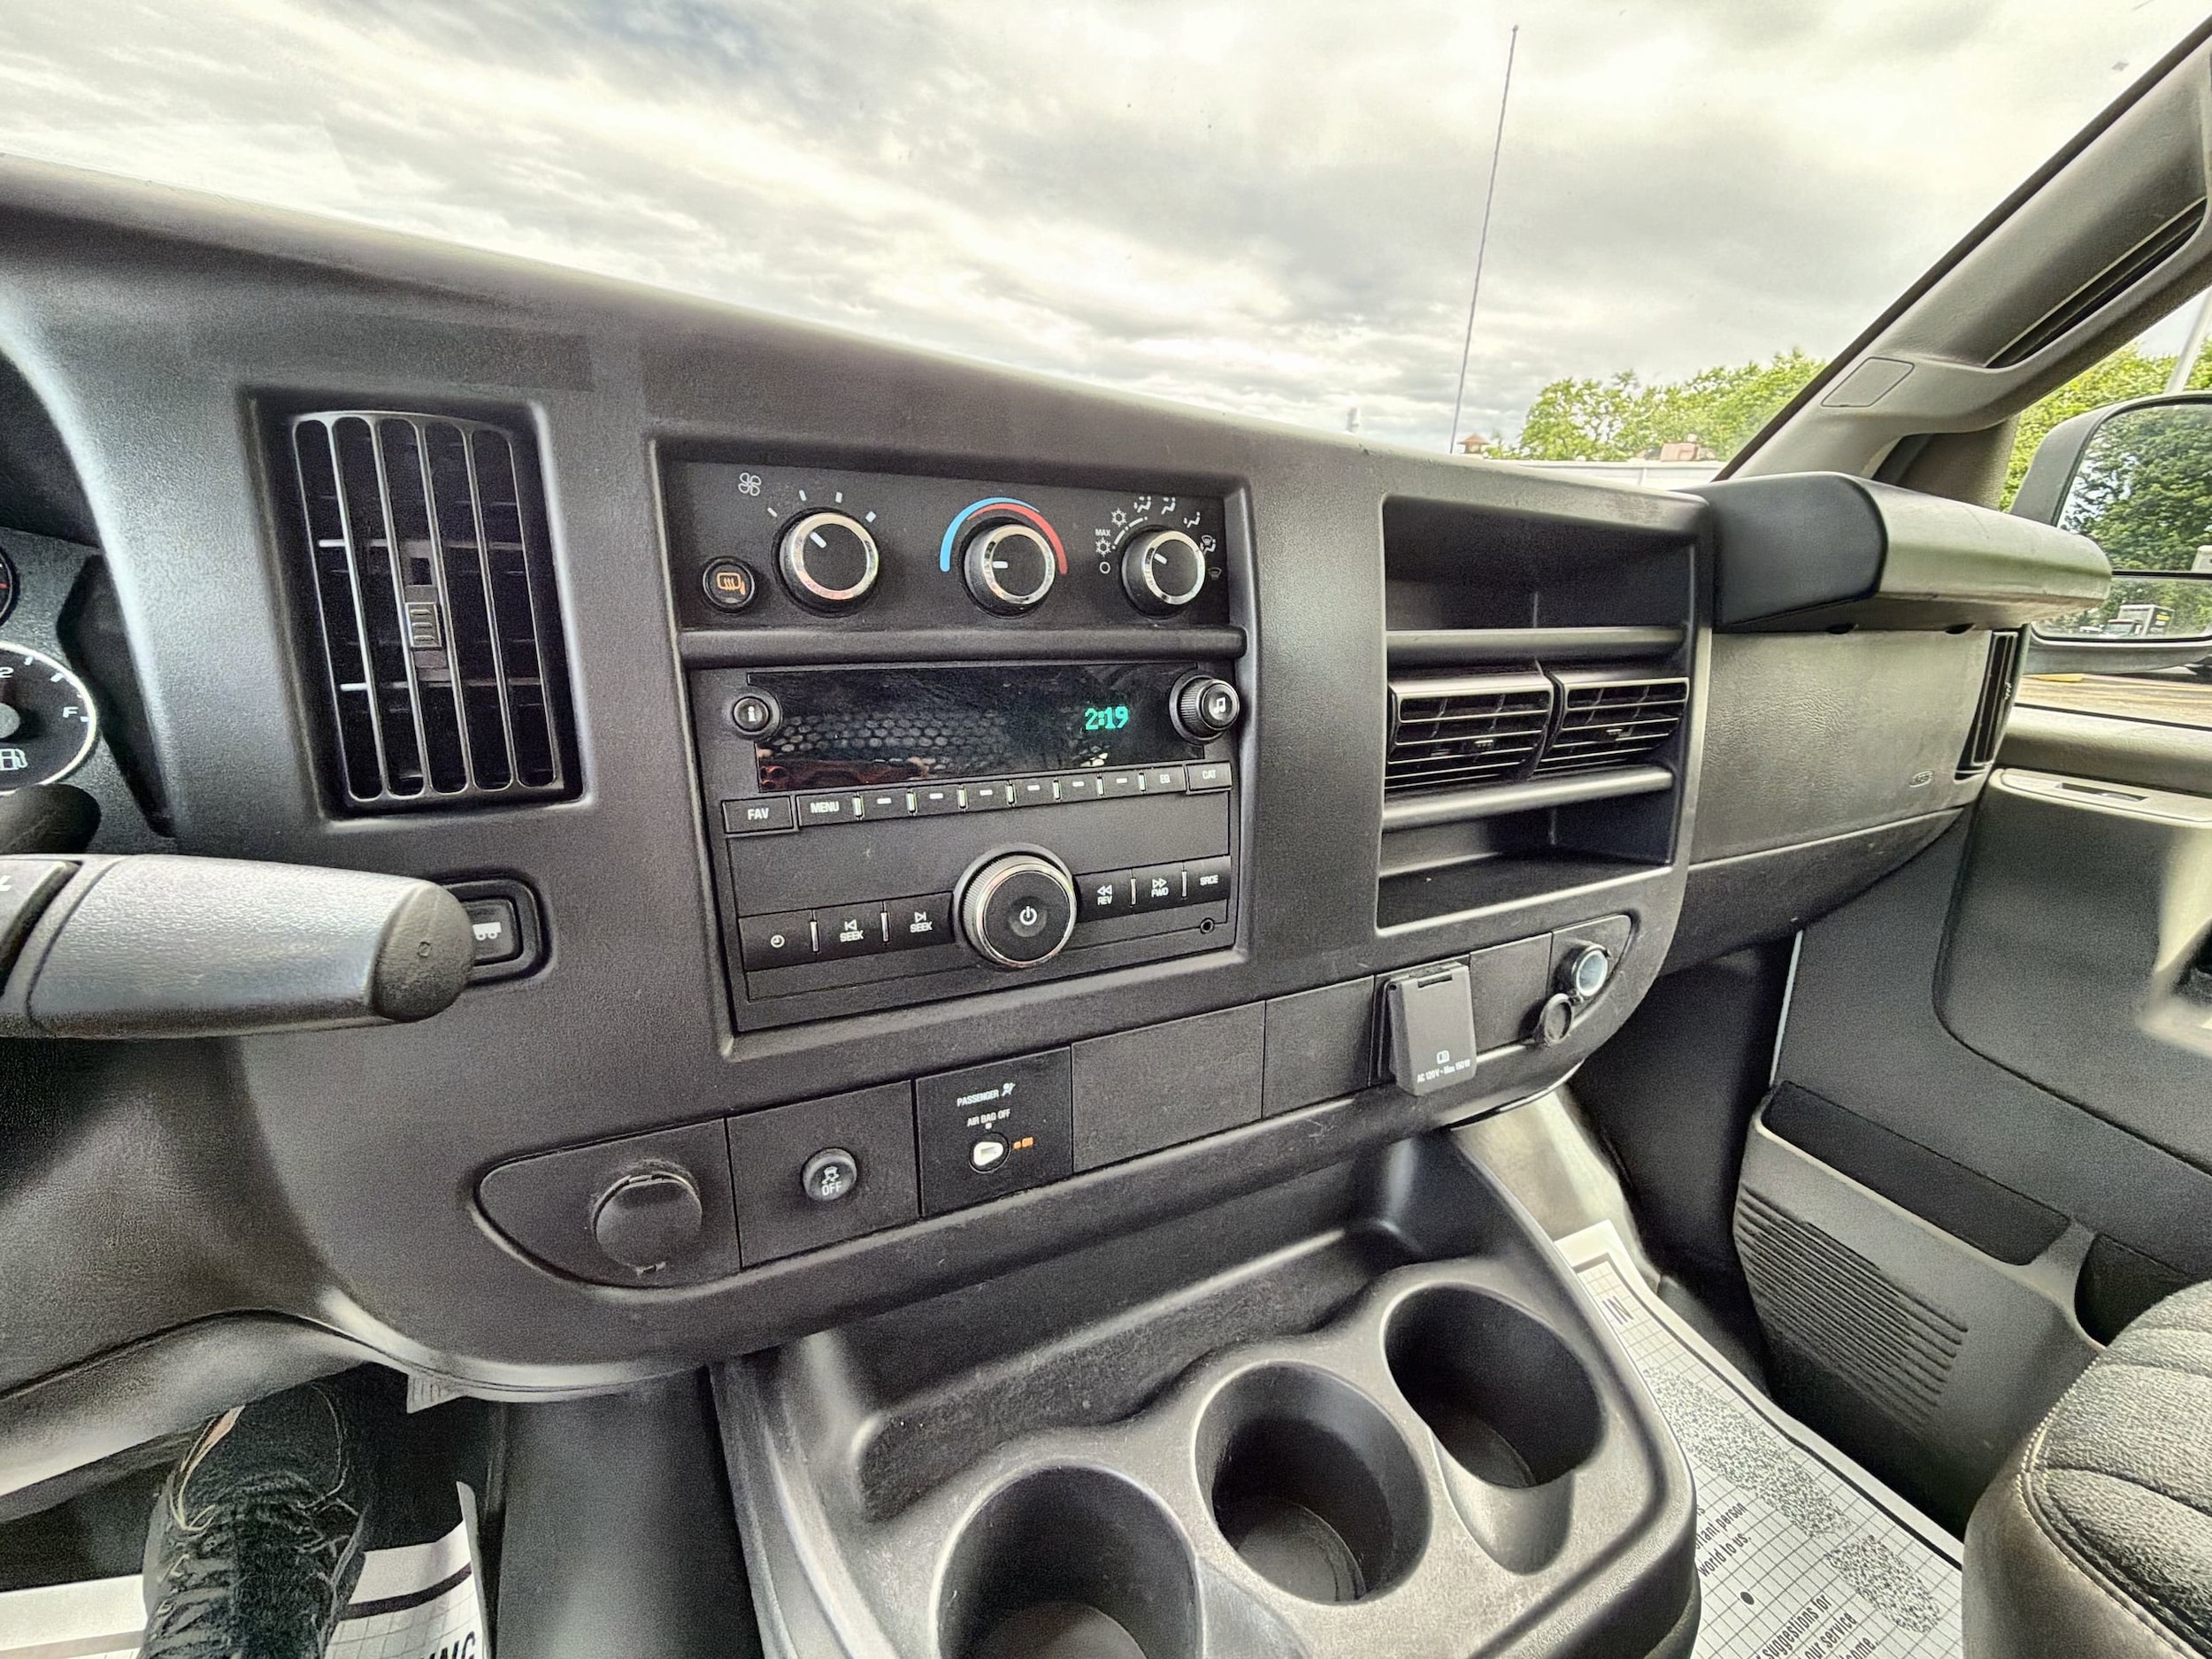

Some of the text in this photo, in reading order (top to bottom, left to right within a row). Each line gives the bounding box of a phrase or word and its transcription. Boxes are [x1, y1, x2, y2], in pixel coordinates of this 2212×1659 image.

[1094, 528, 1111, 537] MAX
[63, 706, 79, 718] F
[1084, 705, 1129, 730] 2:19
[1202, 770, 1217, 780] CAT
[810, 801, 841, 813] MENU
[747, 807, 769, 820] FAV
[1200, 874, 1219, 886] SRCE
[1151, 887, 1169, 898] FWD
[1097, 895, 1113, 906] REV
[910, 921, 933, 933] SEEK
[840, 930, 864, 942] SEEK
[956, 1089, 1000, 1107] PASSENGER
[967, 1108, 1010, 1127] AIR BAG OFF
[821, 1180, 842, 1196] OFF
[1715, 1502, 1748, 1532] person
[1698, 1548, 1727, 1578] world
[1718, 1542, 1737, 1557] to
[1762, 1594, 1832, 1659] suggestions for
[1820, 1611, 1857, 1649] service
